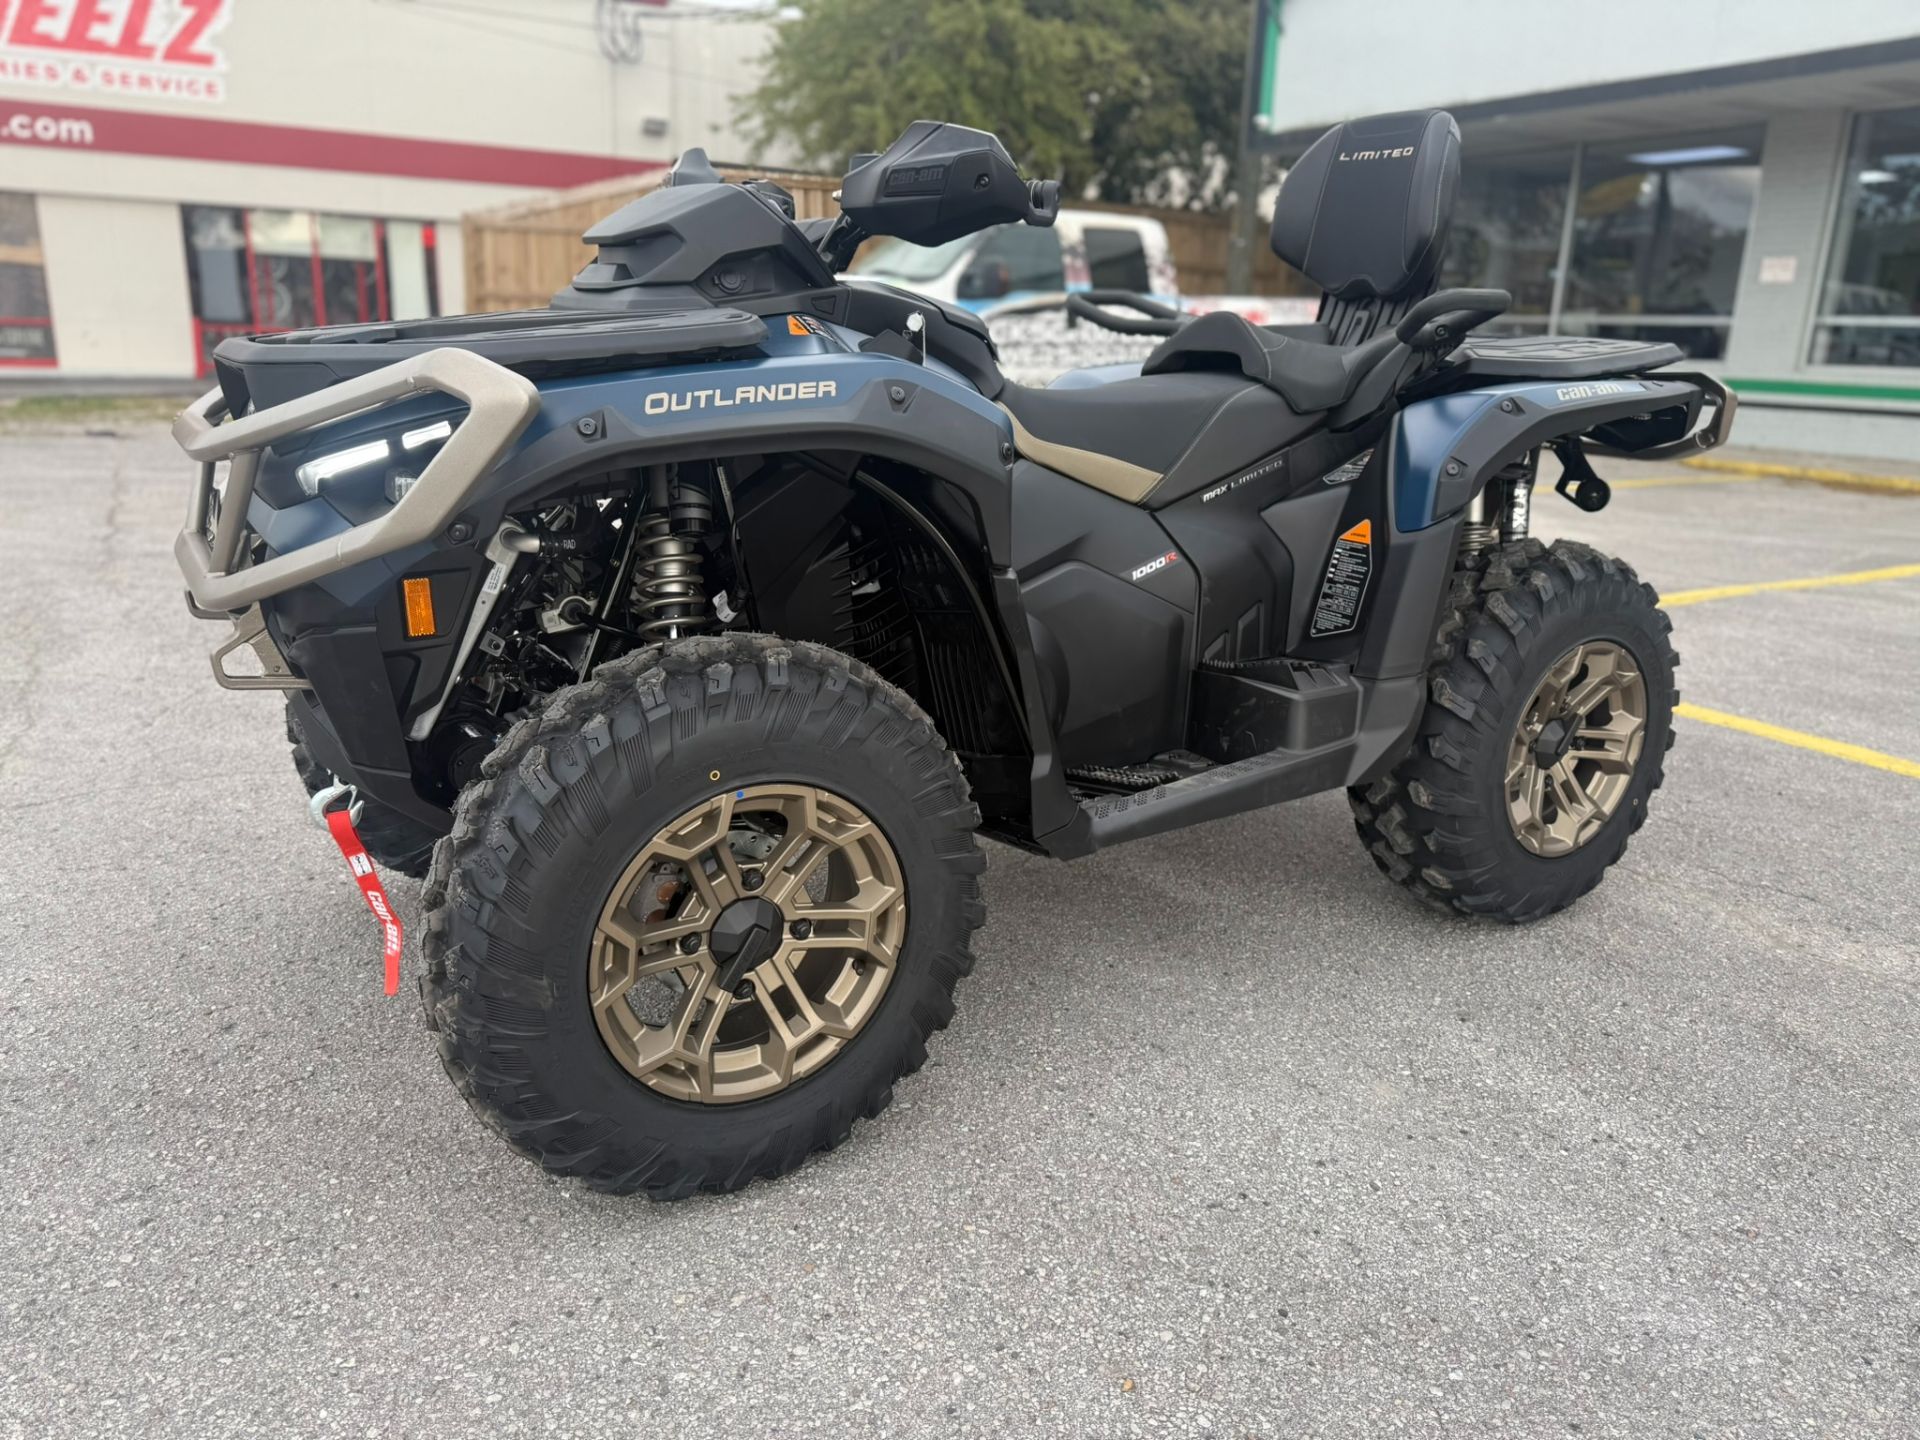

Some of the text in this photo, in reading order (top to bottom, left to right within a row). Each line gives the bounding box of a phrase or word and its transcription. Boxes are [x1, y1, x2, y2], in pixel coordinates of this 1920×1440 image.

[0, 0, 220, 66] EELZ
[101, 70, 218, 96] SERVICE
[1339, 146, 1415, 161] LIMITED
[644, 380, 837, 415] OUTLANDER
[1203, 459, 1283, 502] MAX LIMITED
[563, 539, 577, 550] RAD
[1132, 551, 1178, 581] 1000R
